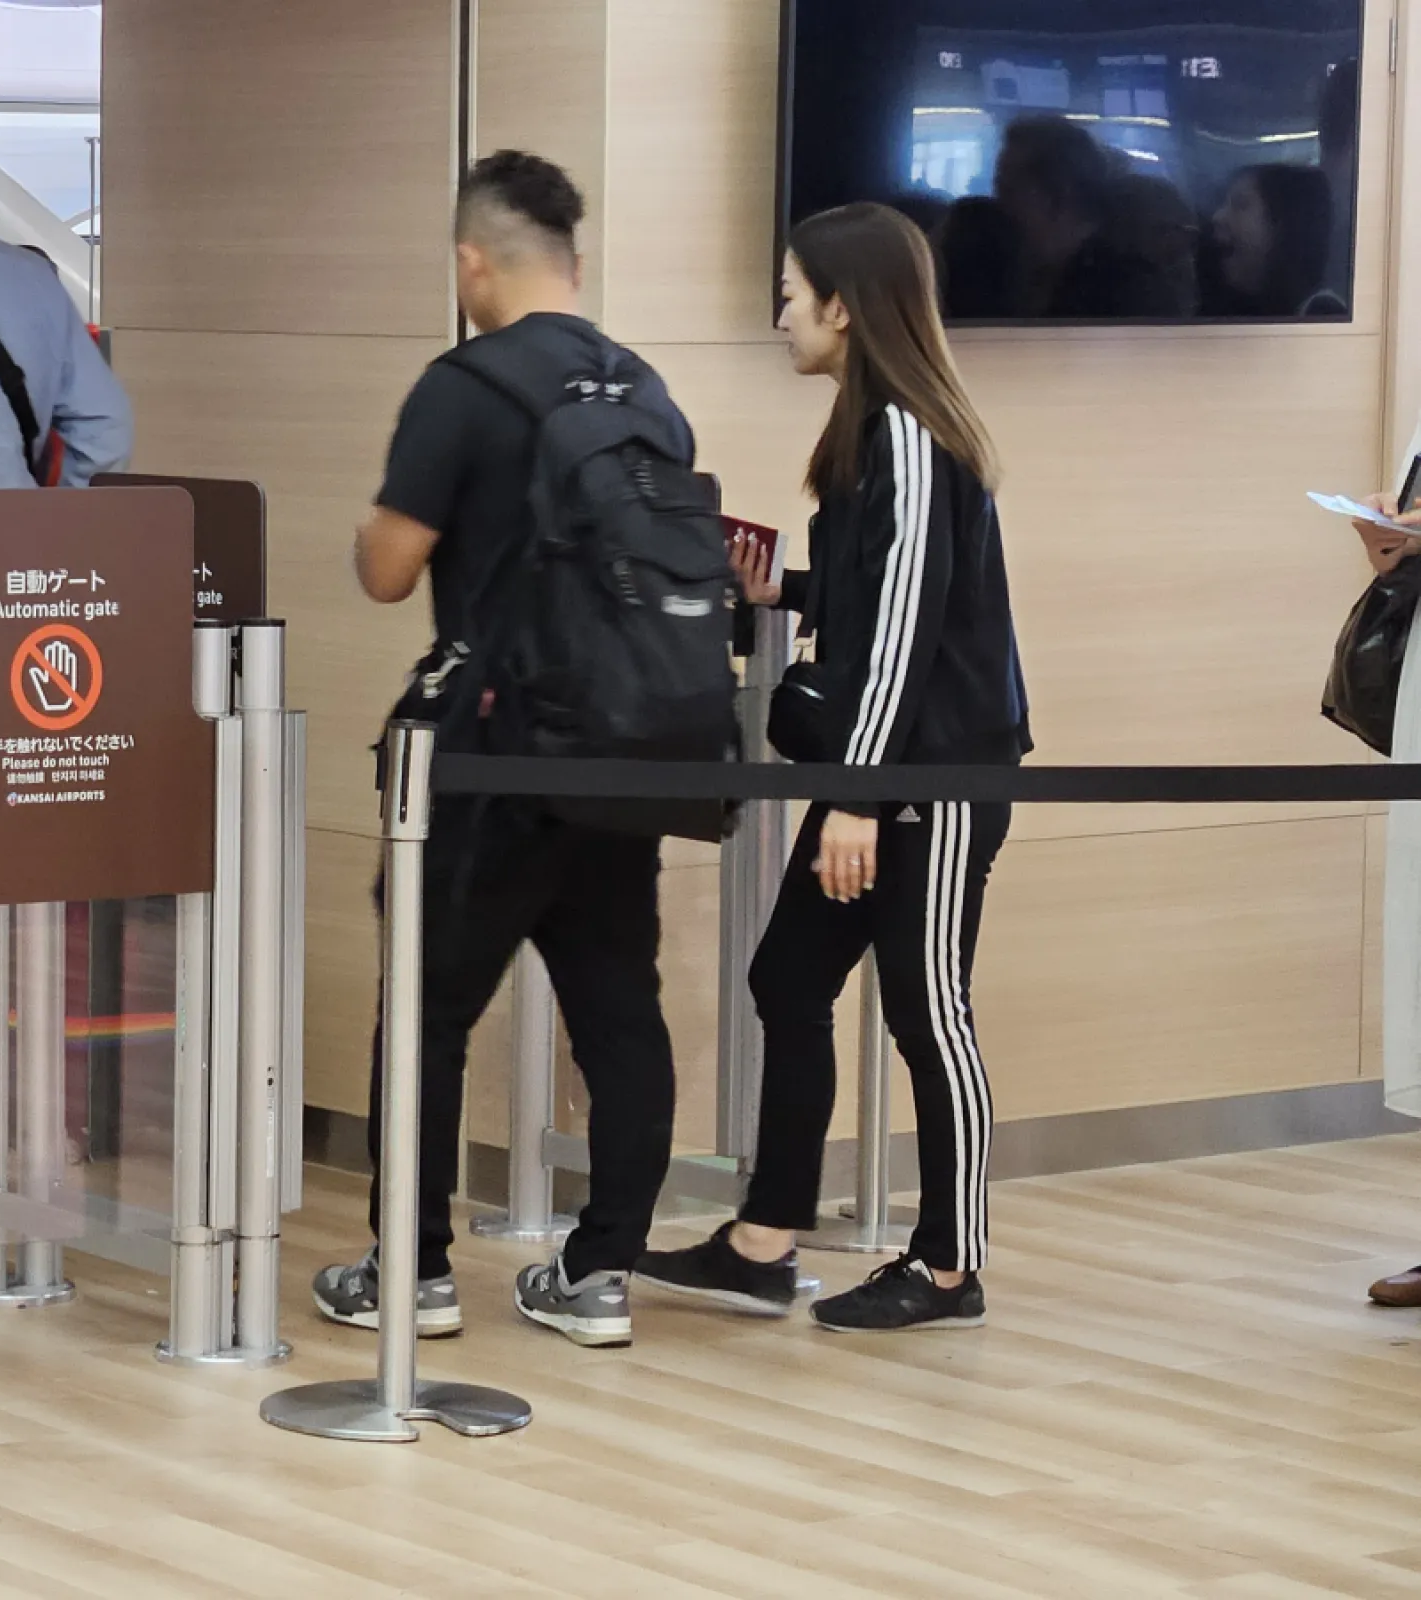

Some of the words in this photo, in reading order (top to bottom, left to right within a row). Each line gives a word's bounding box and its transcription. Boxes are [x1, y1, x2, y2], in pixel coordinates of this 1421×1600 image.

[7, 570, 105, 593] 自動ゲート
[196, 589, 223, 608] gate
[84, 600, 118, 620] gate
[3, 758, 39, 769] Please
[43, 756, 55, 767] do
[59, 756, 75, 766] not
[79, 753, 109, 765] touch
[18, 794, 54, 803] KANSAI
[56, 791, 105, 801] AIRPORTS
